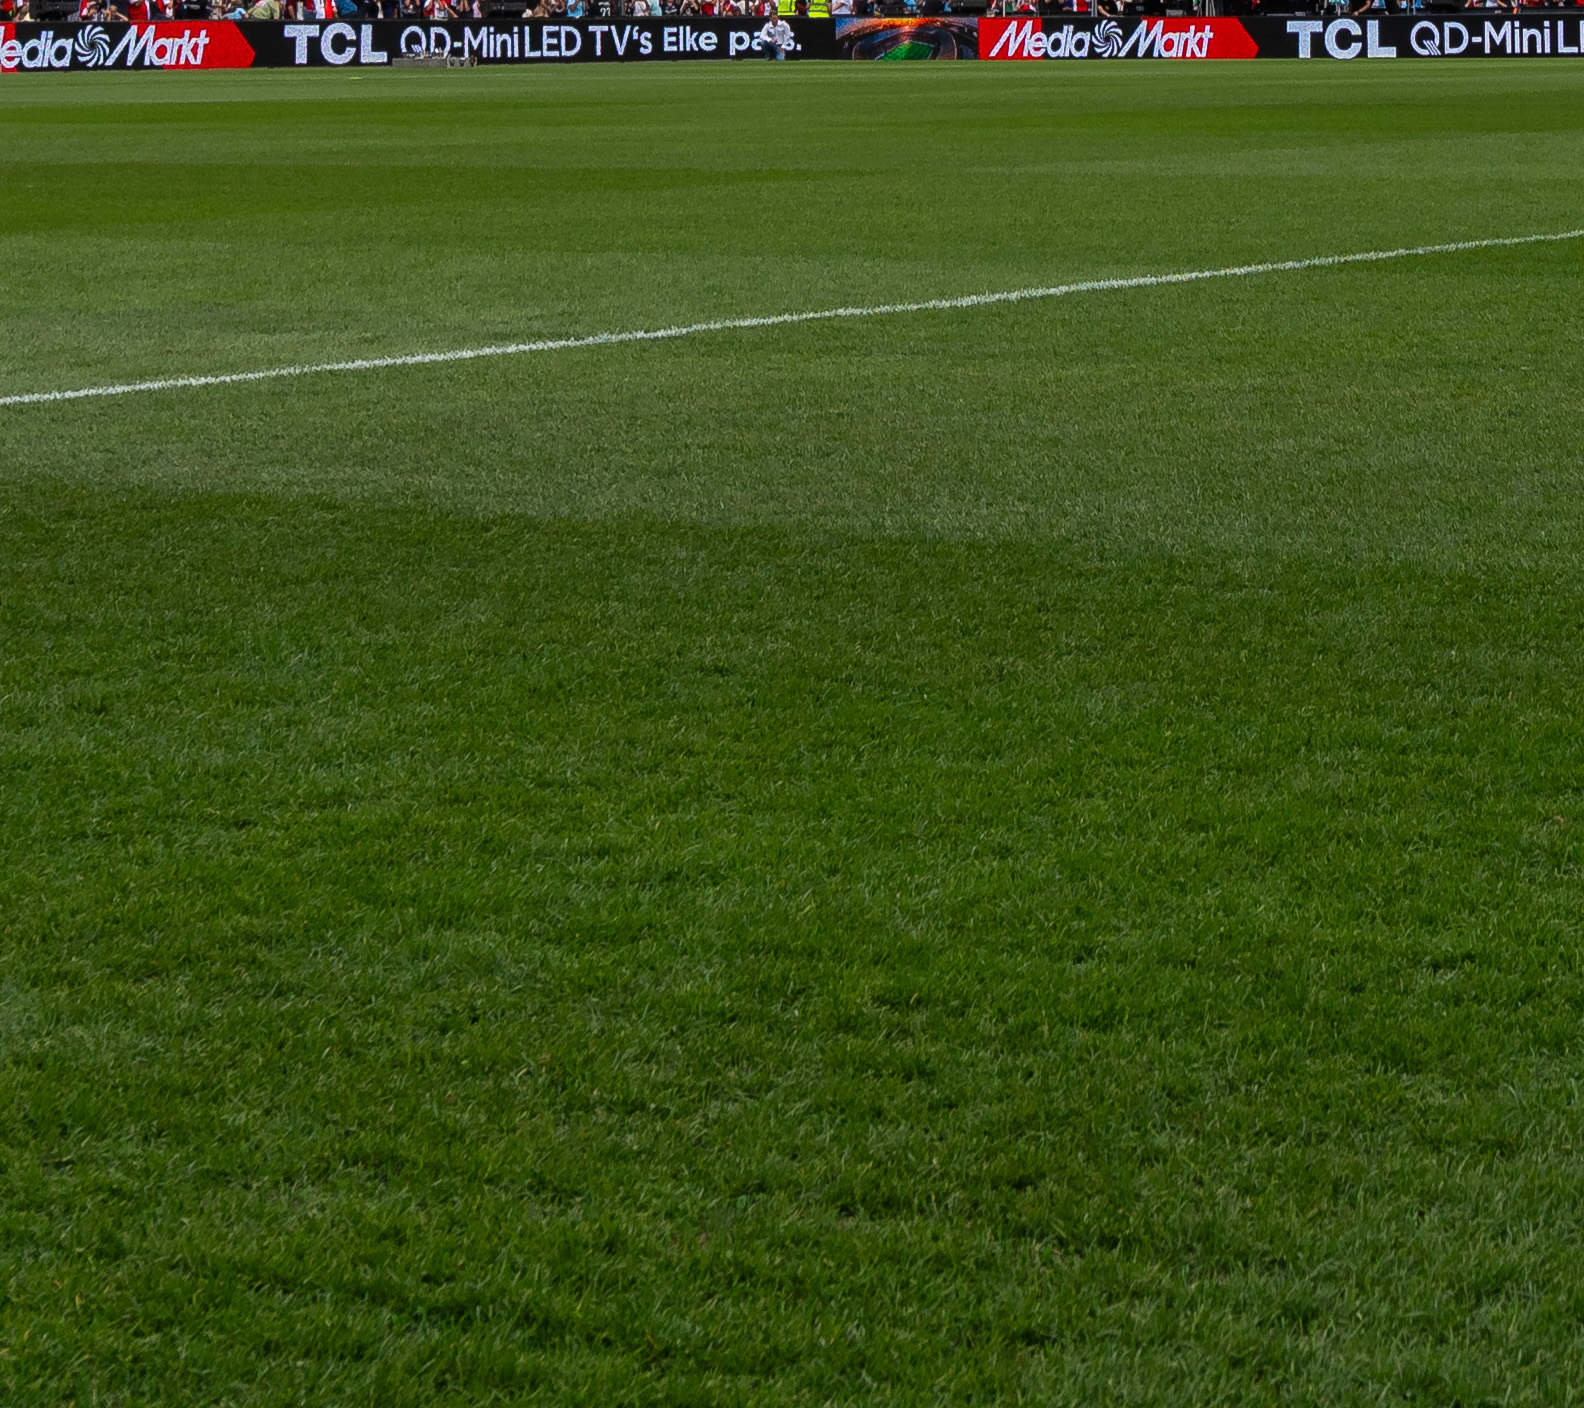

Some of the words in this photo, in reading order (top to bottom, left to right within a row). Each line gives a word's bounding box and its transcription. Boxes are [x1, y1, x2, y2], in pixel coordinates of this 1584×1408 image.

[284, 22, 388, 65] TCL
[663, 24, 718, 52] Elke
[729, 27, 802, 57] pas.
[1286, 19, 1397, 57] TCL
